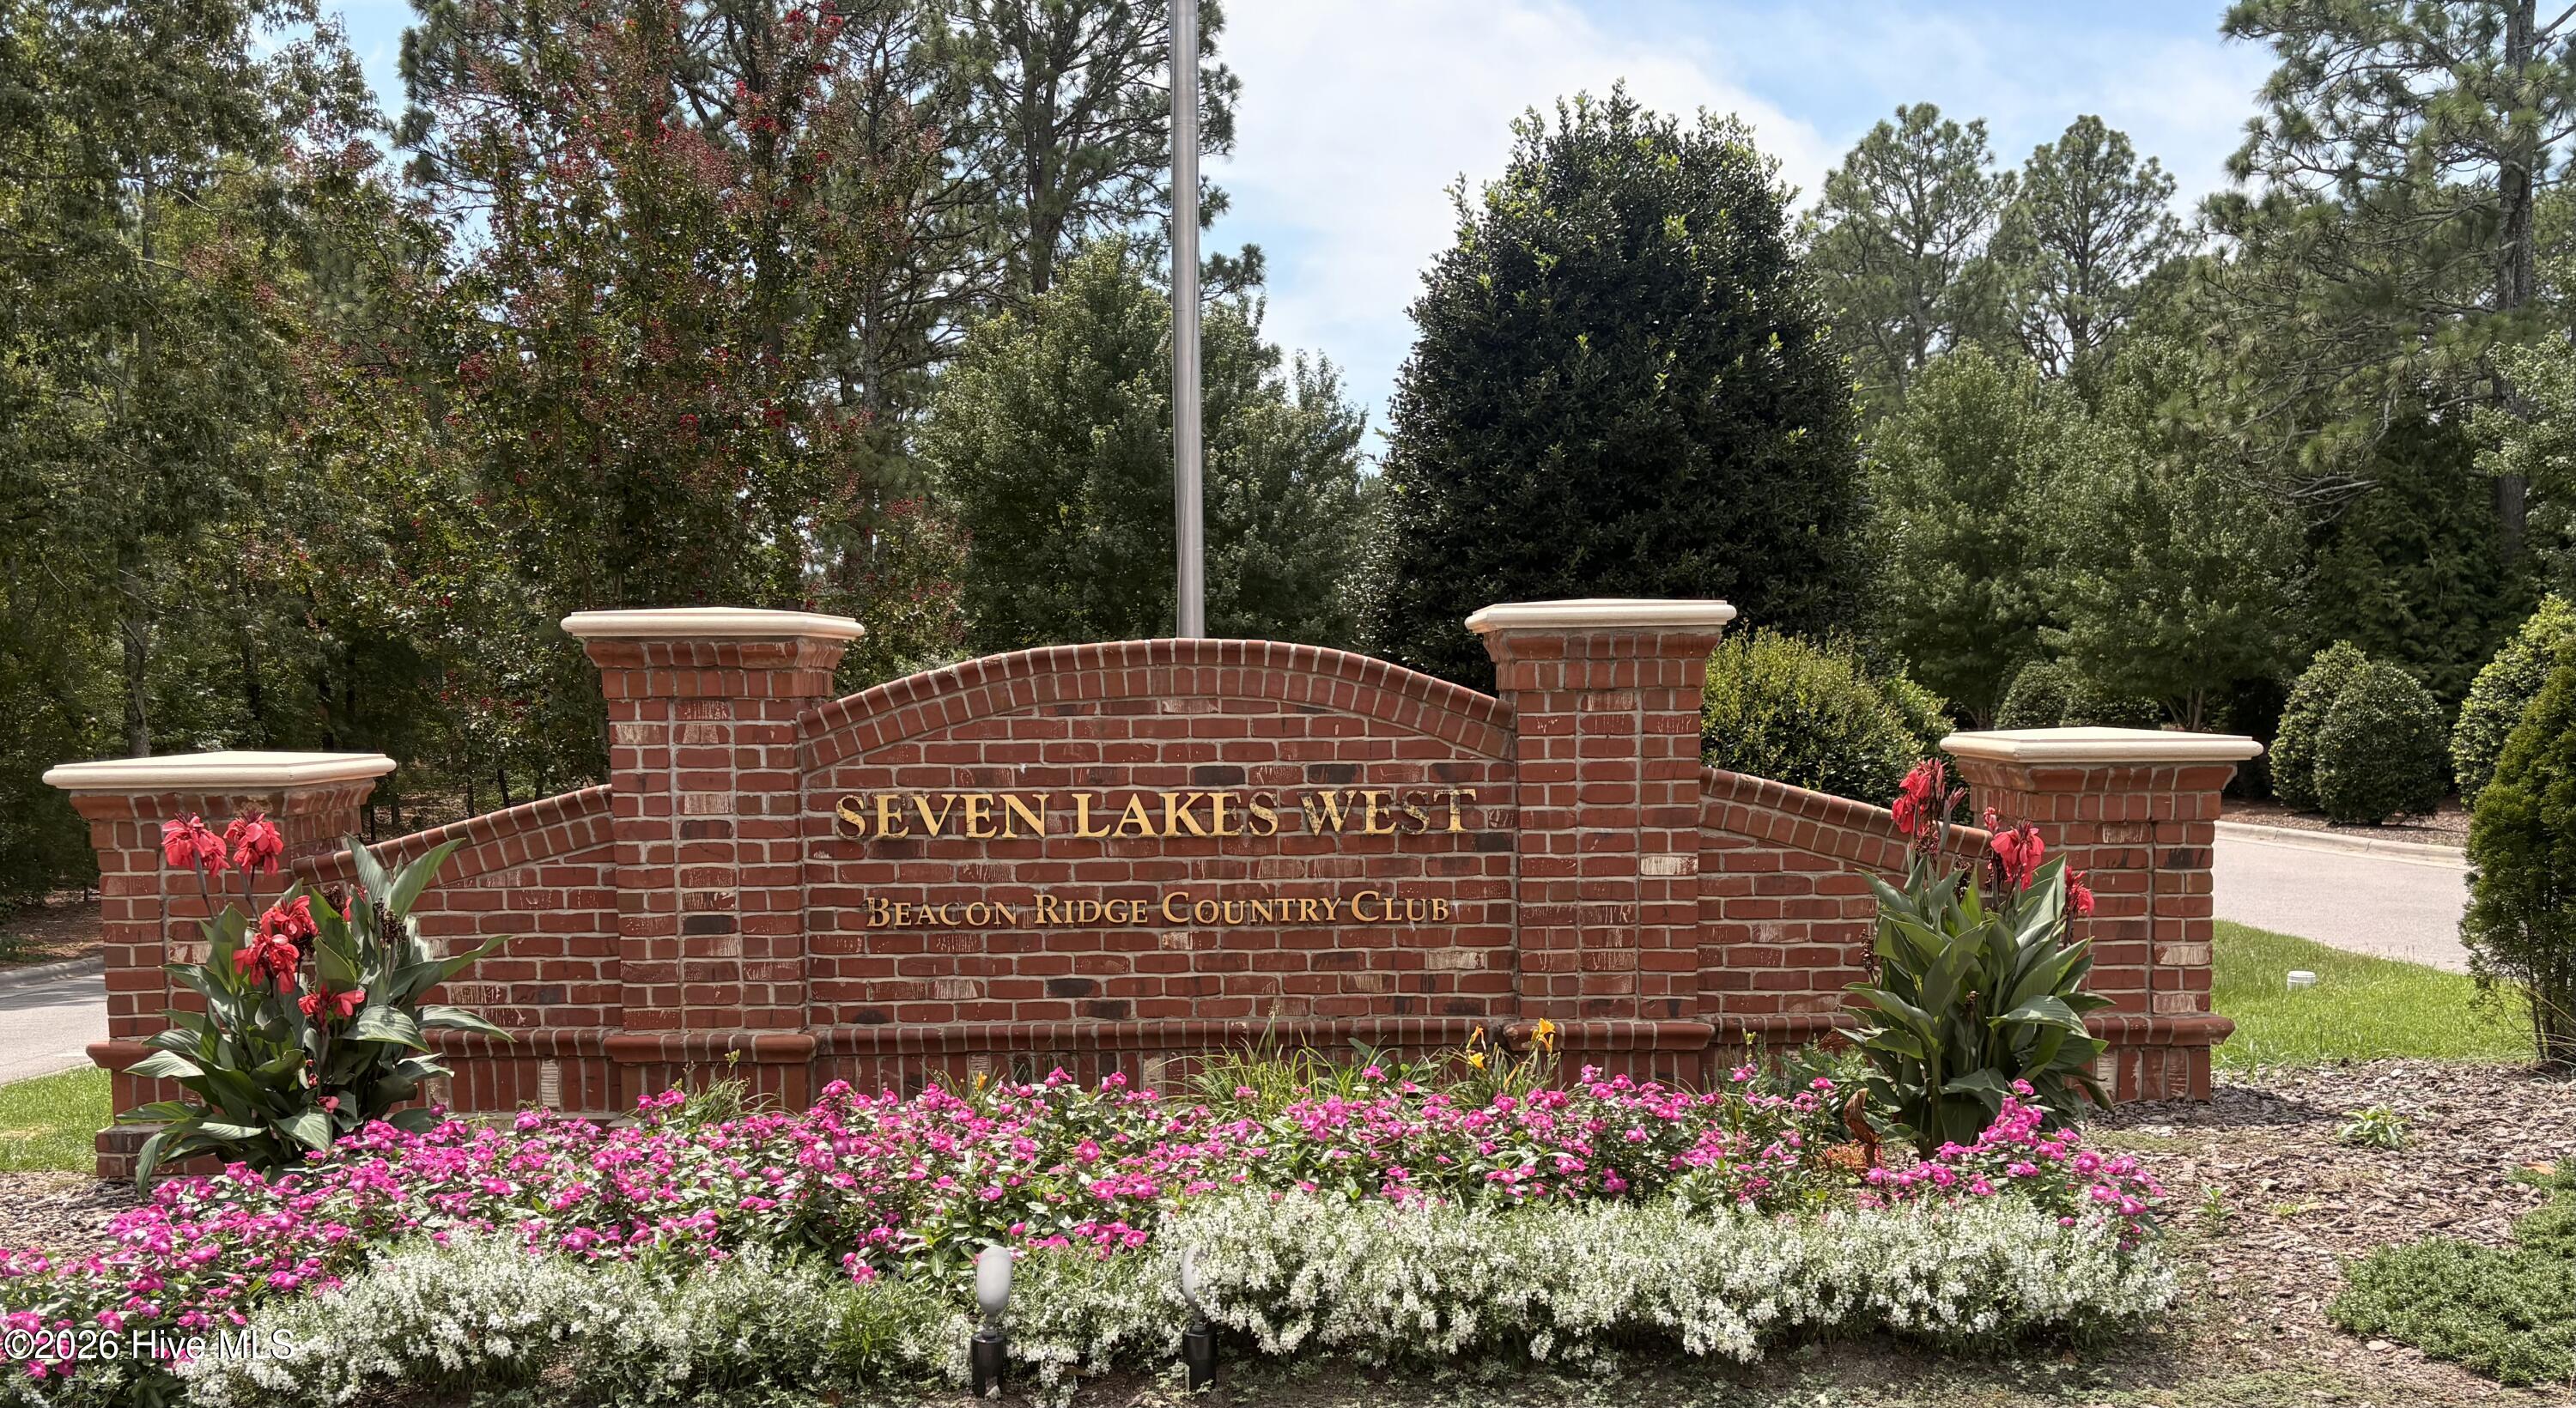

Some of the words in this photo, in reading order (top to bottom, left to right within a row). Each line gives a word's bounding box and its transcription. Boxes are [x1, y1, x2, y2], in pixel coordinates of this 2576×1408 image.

[835, 792, 1049, 839] SEVEN
[1072, 790, 1279, 838] LAKES
[1297, 789, 1477, 836] WEST
[866, 896, 1018, 927] BEACON
[1033, 894, 1149, 925] RIDGE
[1162, 891, 1341, 925] COUNTRY
[1351, 890, 1449, 923] CLUB
